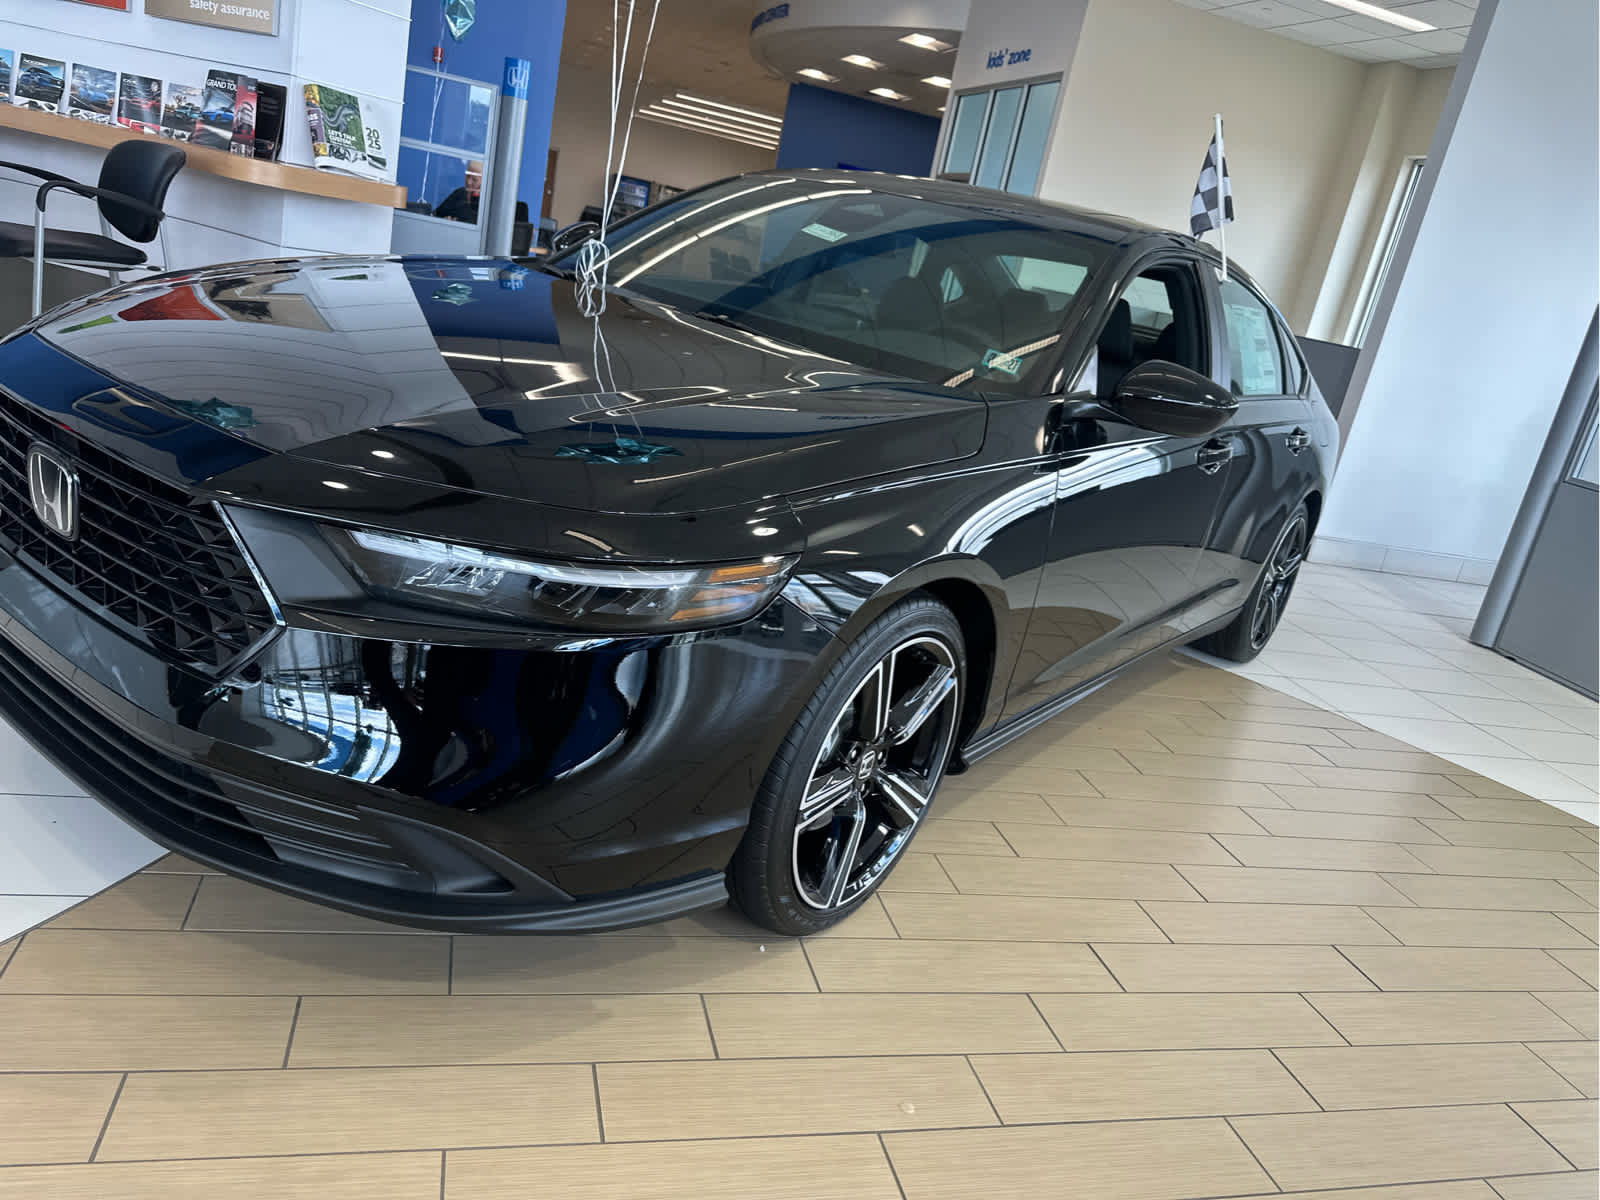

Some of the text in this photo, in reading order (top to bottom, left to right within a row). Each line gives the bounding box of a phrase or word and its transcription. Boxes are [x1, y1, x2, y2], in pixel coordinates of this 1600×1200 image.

[190, 0, 270, 20] safety assurance
[1008, 49, 1032, 65] zone
[206, 79, 226, 89] GRAND
[365, 127, 380, 140] 20
[367, 138, 382, 150] 25
